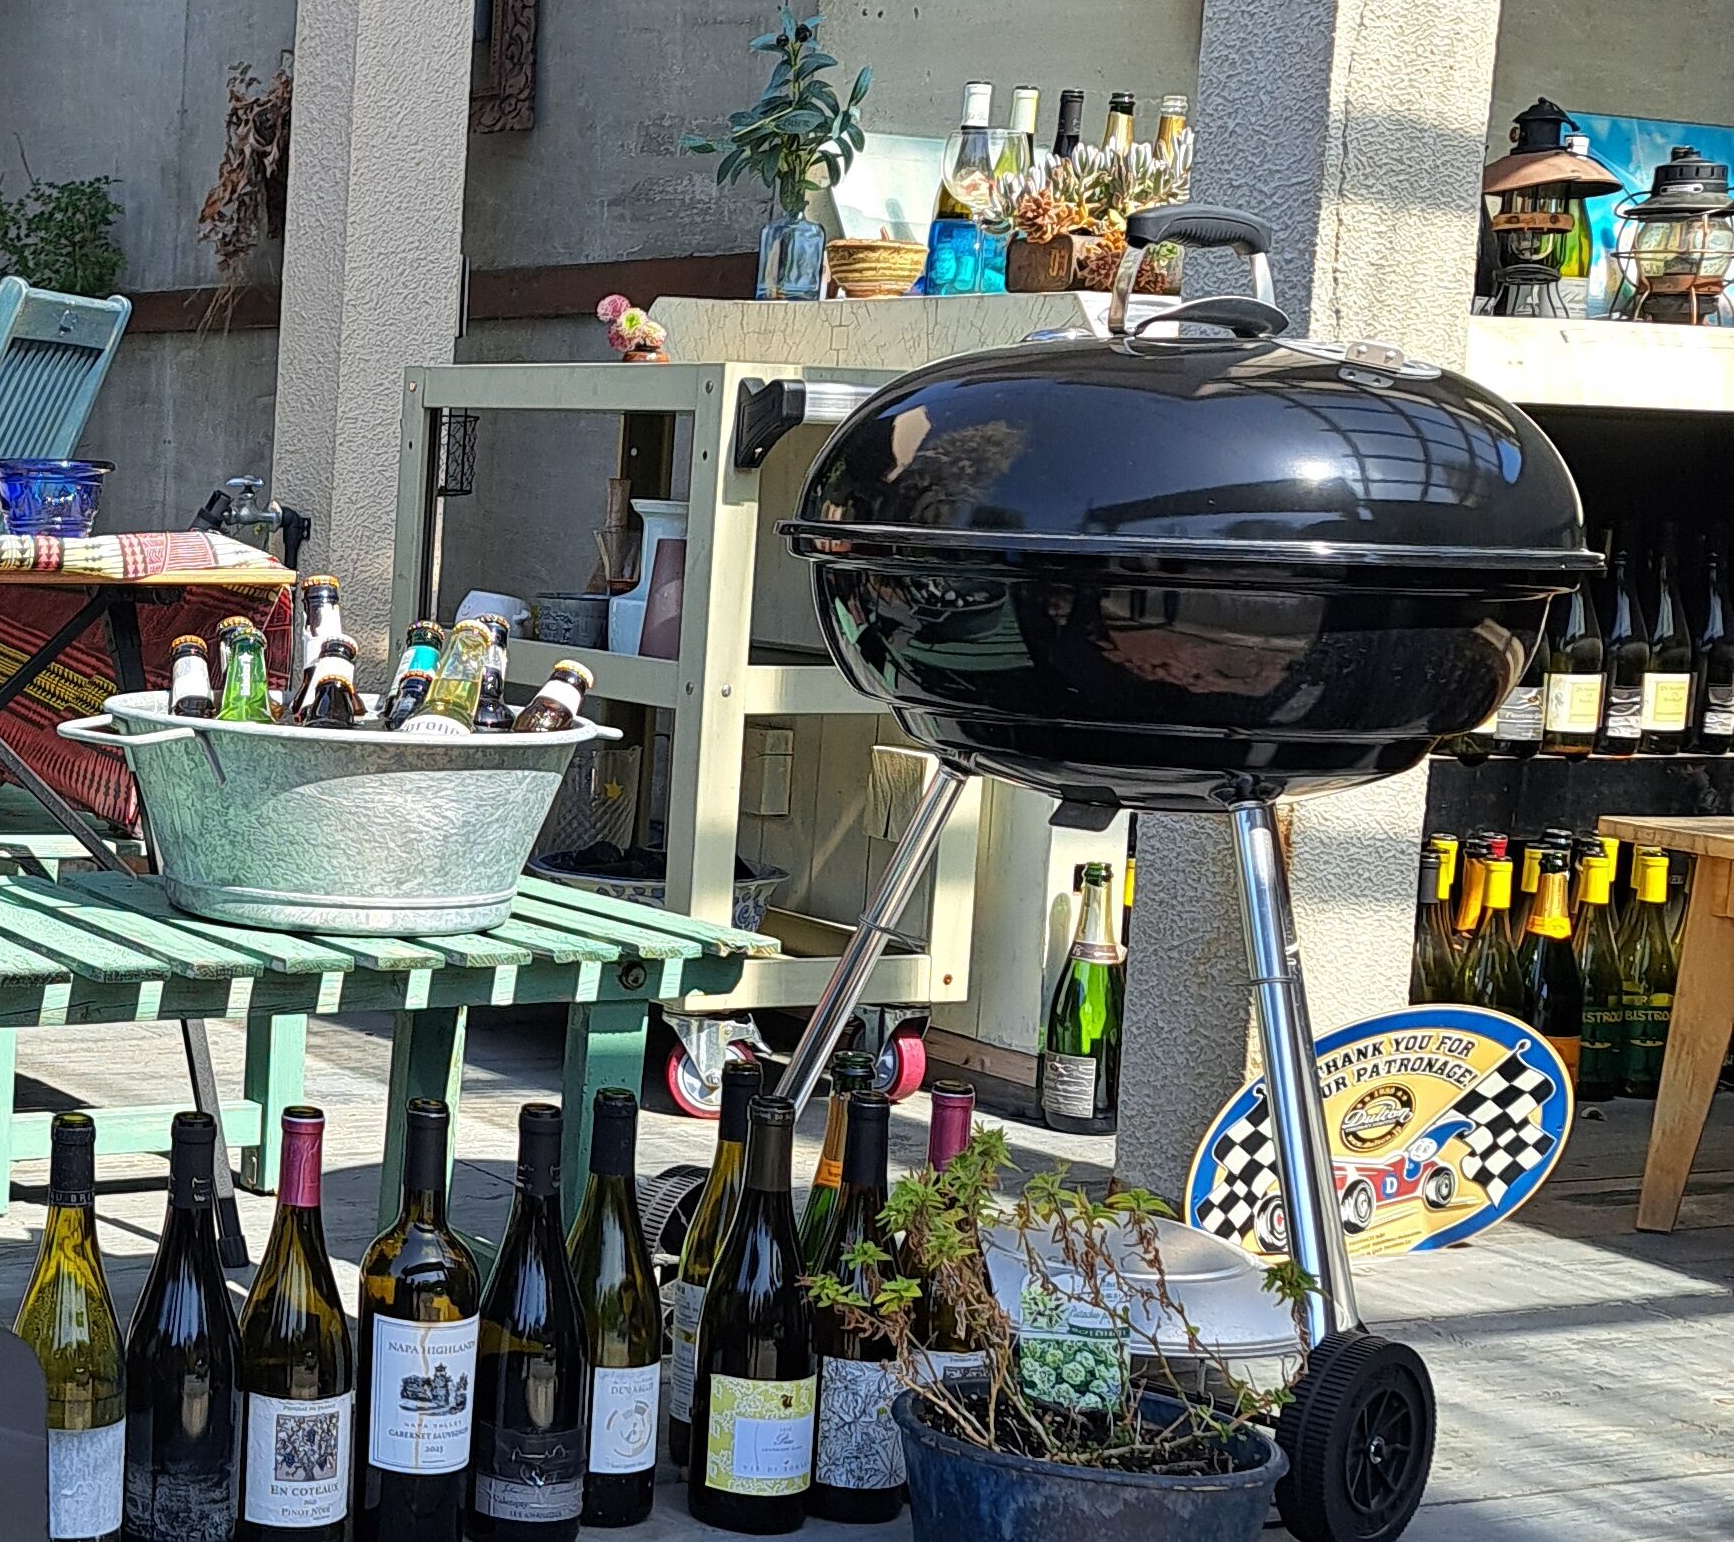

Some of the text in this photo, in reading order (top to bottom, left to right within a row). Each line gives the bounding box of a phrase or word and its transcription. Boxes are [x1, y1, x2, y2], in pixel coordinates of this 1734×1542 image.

[1318, 1035, 1476, 1079] THANK YOU FOR
[1321, 1056, 1478, 1099] UR PATRONAGE!
[1385, 1176, 1398, 1194] D
[388, 1341, 419, 1354] NAPA
[270, 1482, 340, 1496] EN COTEAUX
